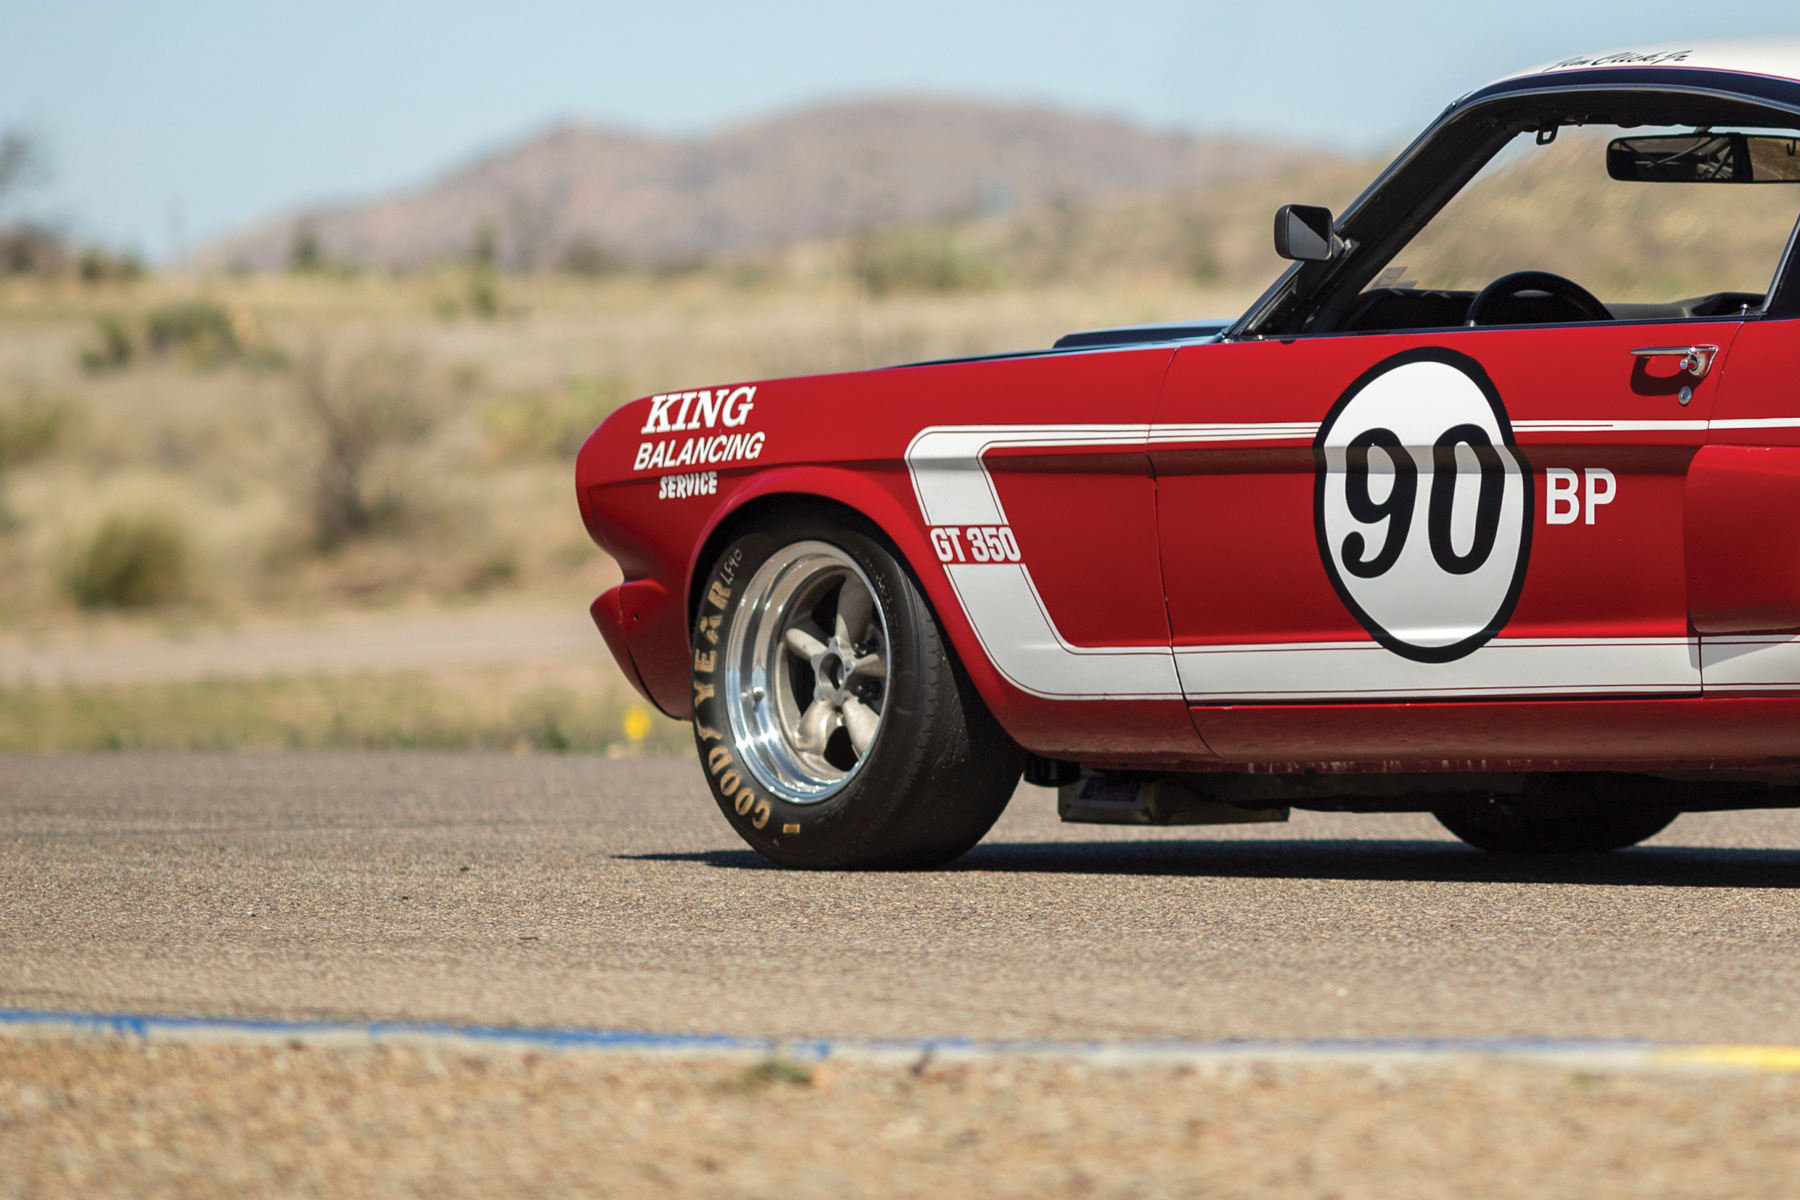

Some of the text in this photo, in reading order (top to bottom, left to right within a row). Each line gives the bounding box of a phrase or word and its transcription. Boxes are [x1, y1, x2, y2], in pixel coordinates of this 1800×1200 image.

[641, 386, 757, 434] KING
[633, 431, 766, 471] BALANCING
[658, 471, 718, 500] SERVICE
[1341, 423, 1505, 578] 90
[1546, 468, 1617, 525] BP
[930, 526, 1022, 562] GT 350
[693, 580, 772, 831] GOODYEAR
